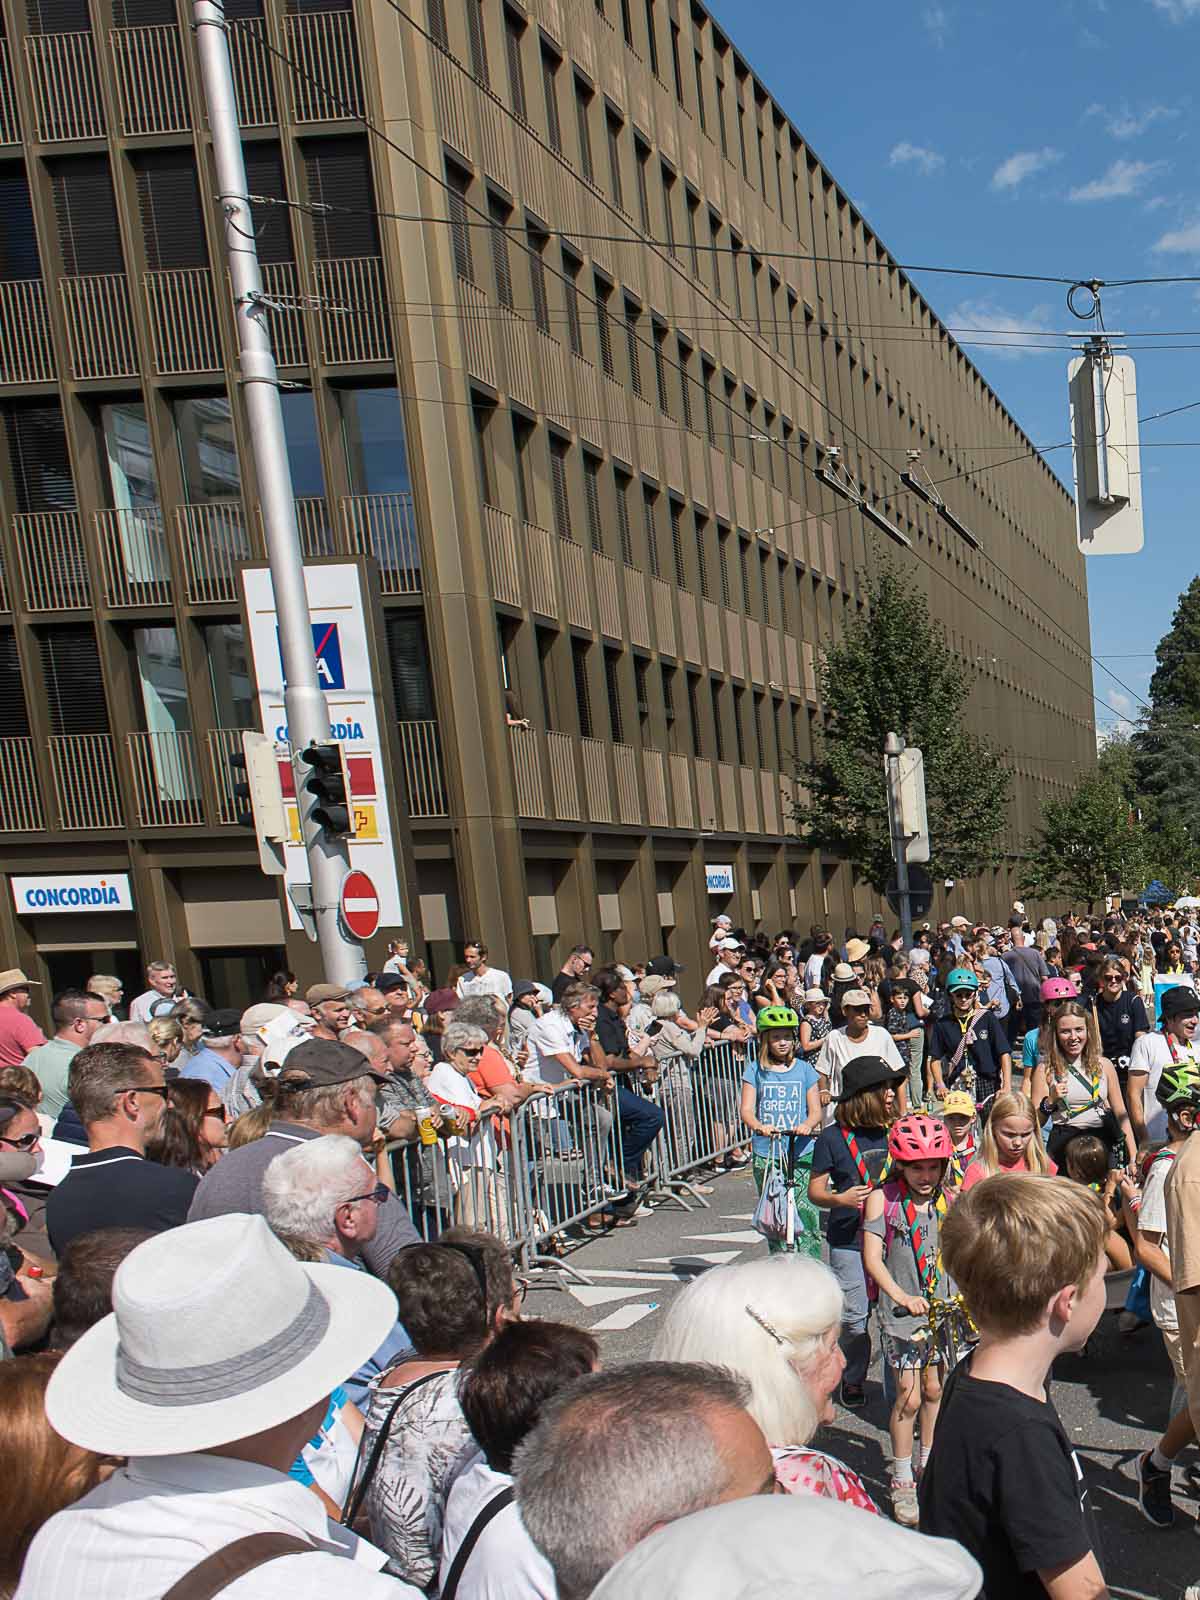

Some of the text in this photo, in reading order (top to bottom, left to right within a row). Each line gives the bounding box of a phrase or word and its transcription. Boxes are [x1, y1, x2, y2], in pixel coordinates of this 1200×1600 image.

[26, 880, 120, 907] CONCORDIA
[763, 1086, 799, 1098] IT'S A
[763, 1100, 798, 1112] GREAT
[763, 1113, 798, 1131] DAY
